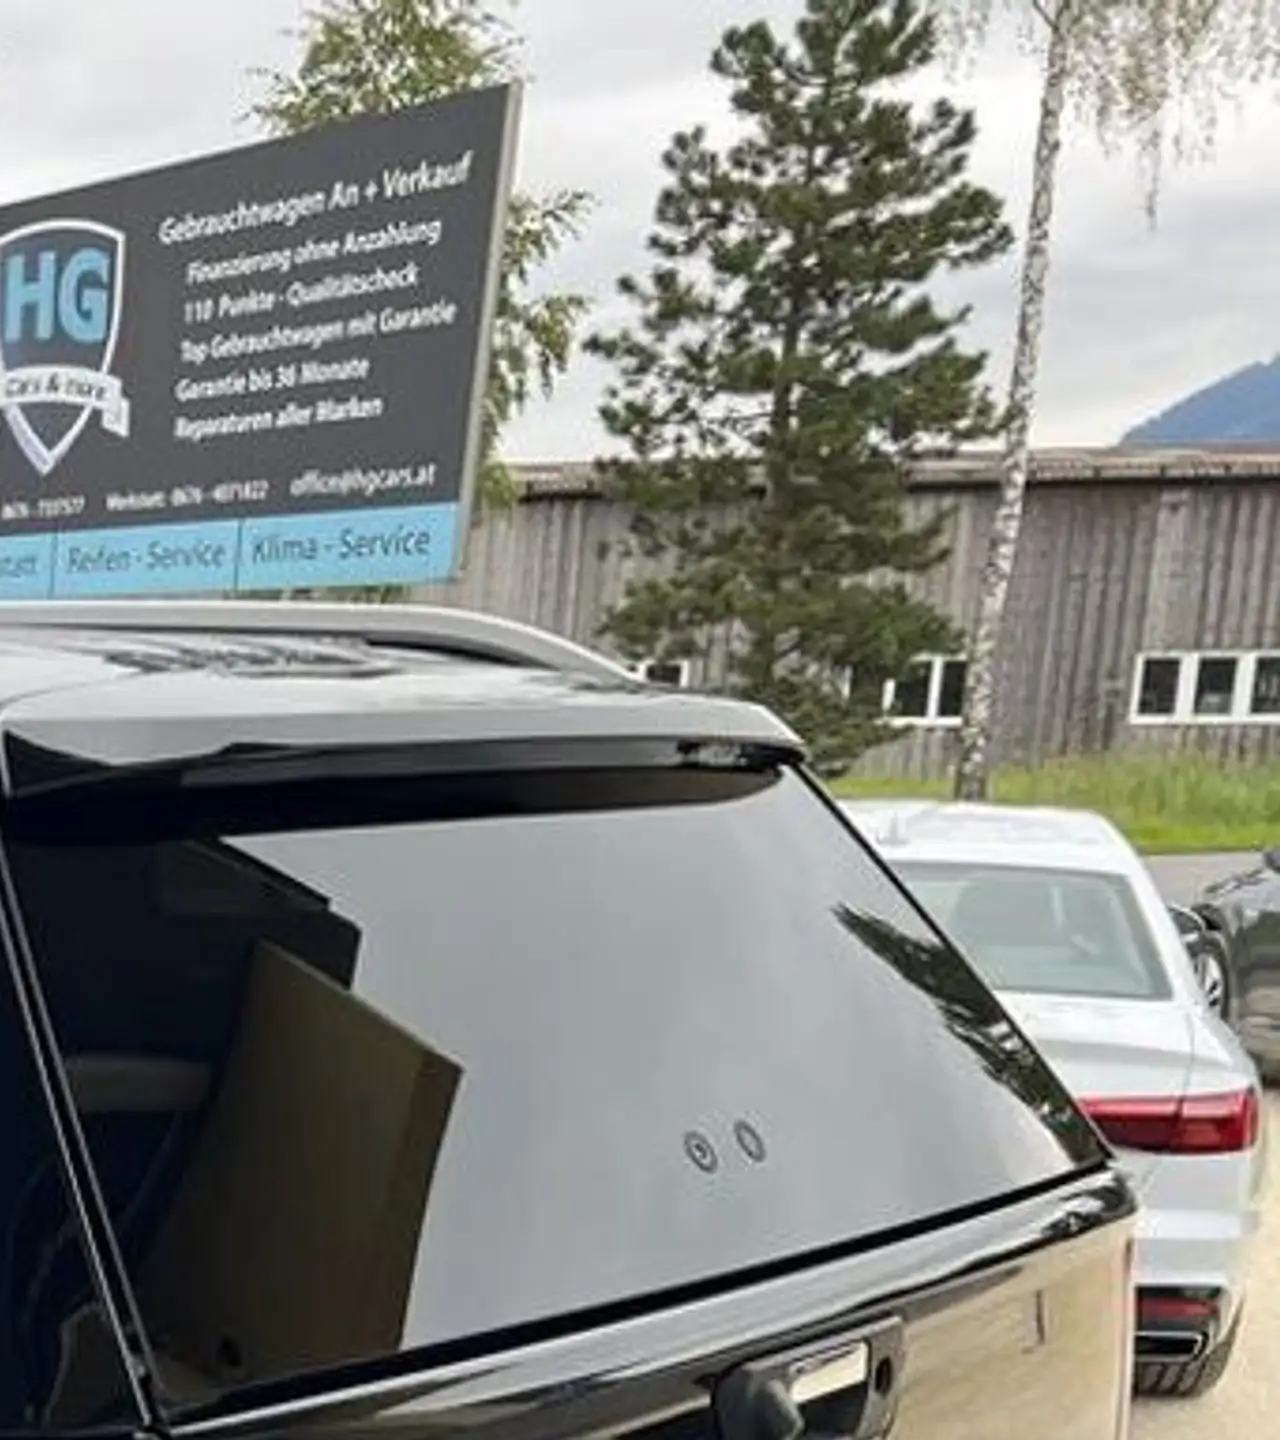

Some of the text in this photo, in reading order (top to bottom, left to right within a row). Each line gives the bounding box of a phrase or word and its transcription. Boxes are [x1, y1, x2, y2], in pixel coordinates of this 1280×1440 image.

[158, 189, 326, 245] Gebrauchtwagen
[328, 180, 360, 211] An
[381, 149, 475, 198] Verkauf
[185, 218, 442, 284] Finanzierung ohne Anzahlung
[3, 247, 111, 344] HG
[210, 320, 345, 359] Gebrauchtwagen
[347, 310, 378, 338] mit
[379, 299, 458, 333] Garantie
[174, 371, 246, 402] Garantie
[249, 368, 273, 392] bis
[300, 357, 370, 384] Monate
[174, 395, 383, 442] Reparaturen aller Marken
[67, 538, 131, 575] Reifen
[146, 533, 226, 571] Service
[251, 531, 320, 564] Klima
[339, 525, 431, 561] Service
